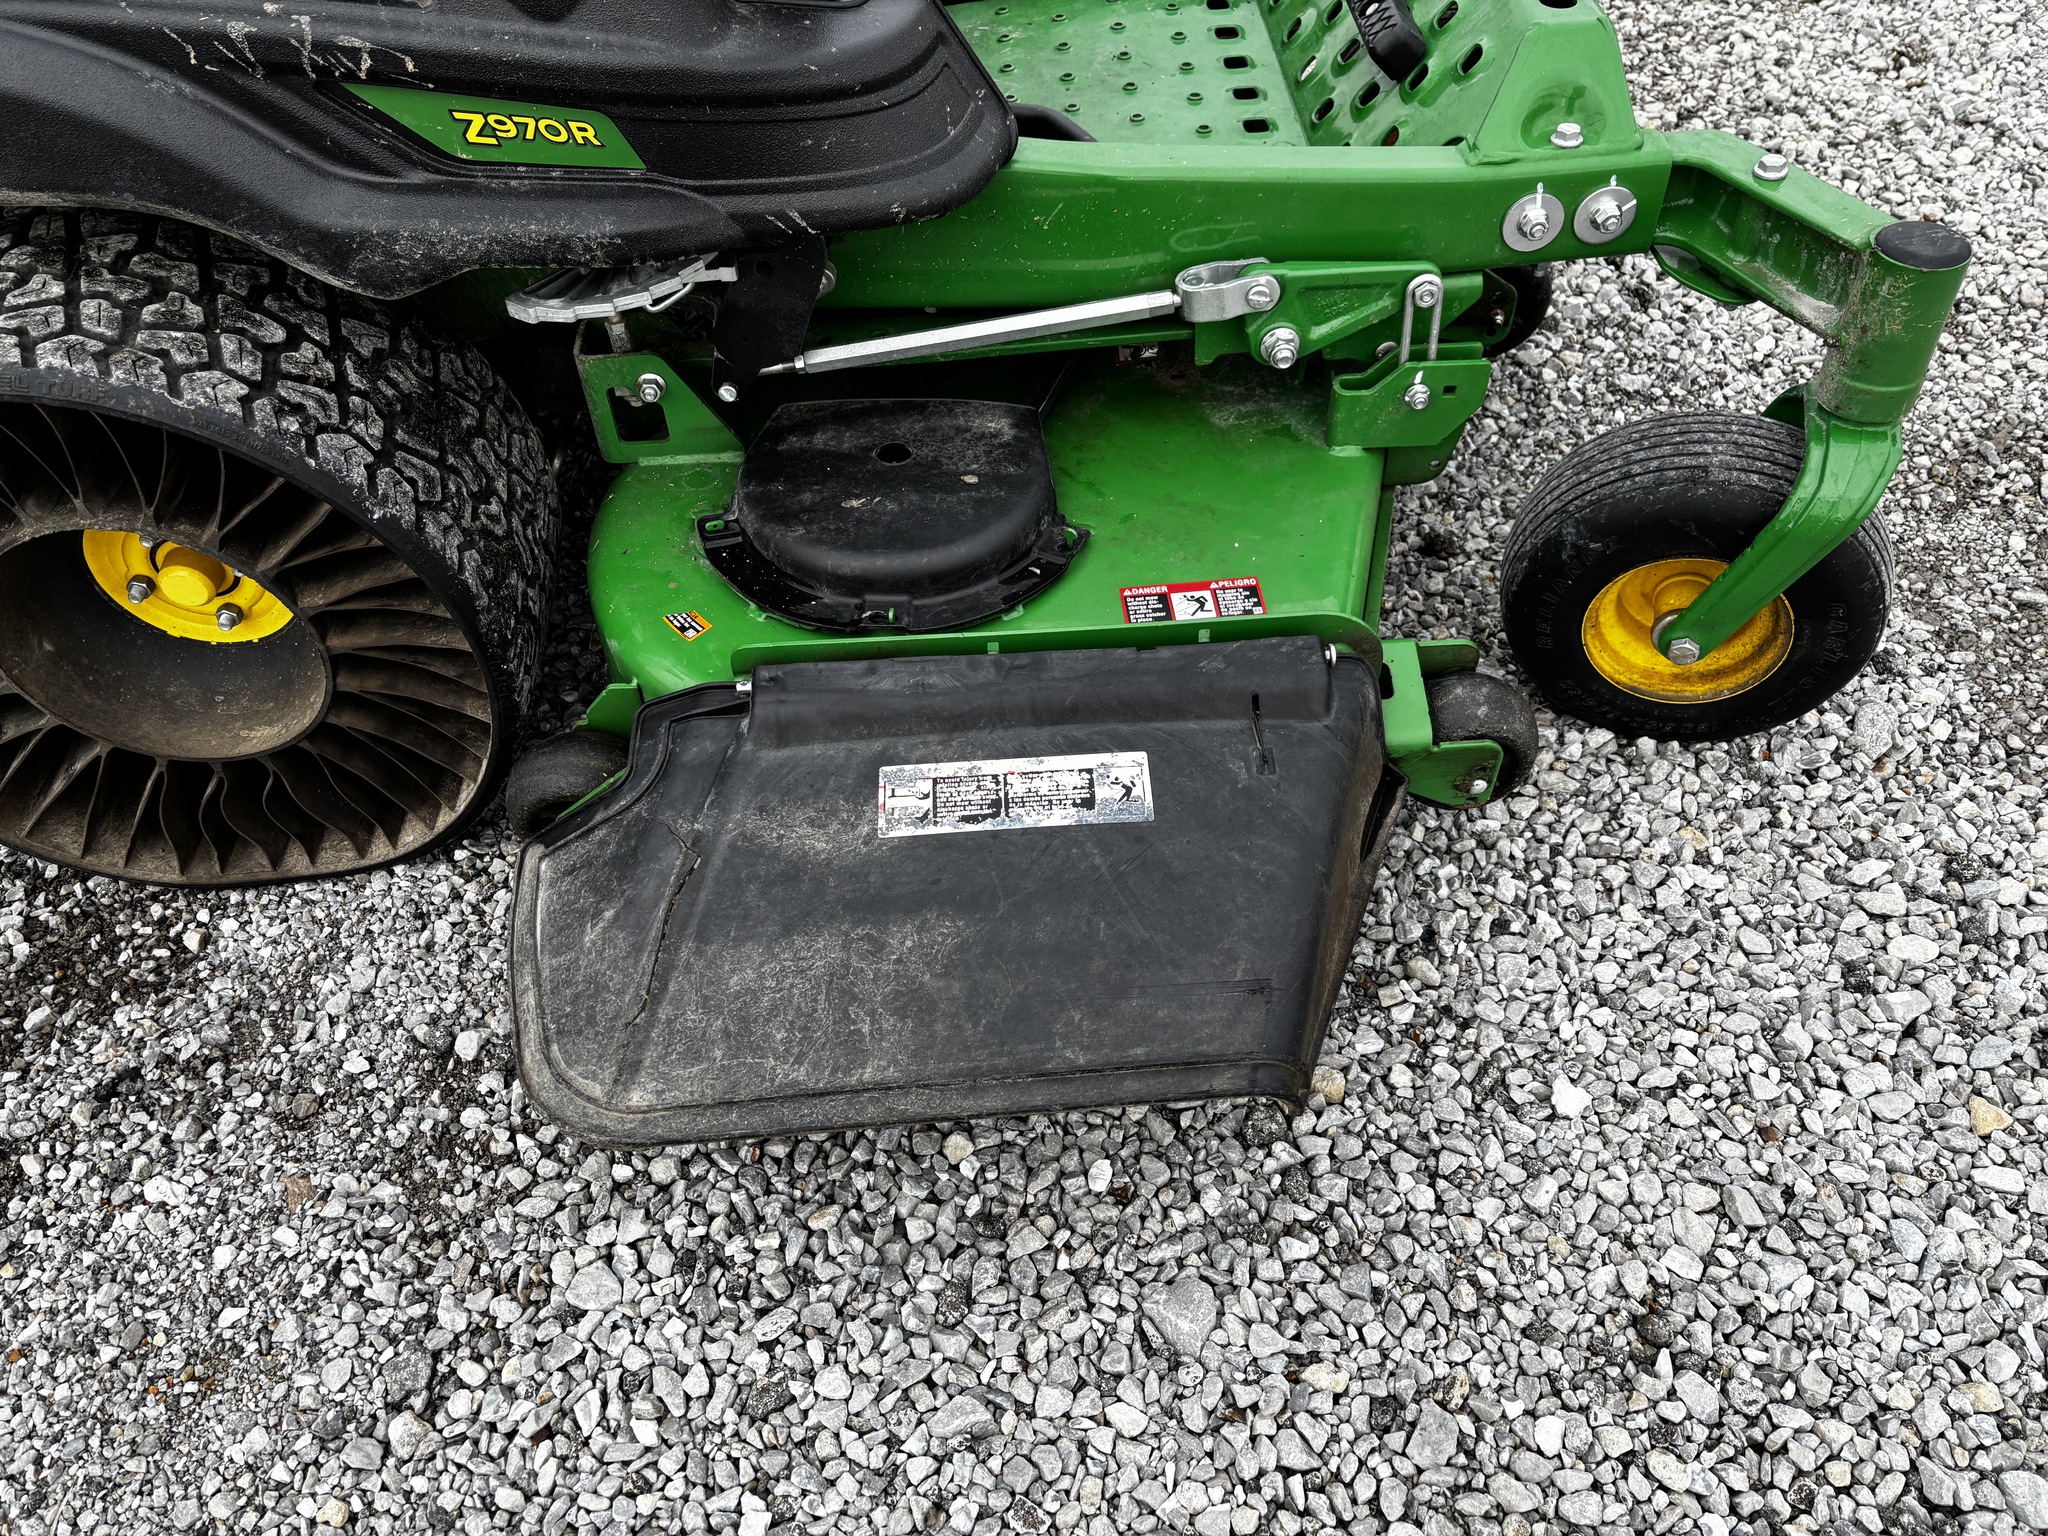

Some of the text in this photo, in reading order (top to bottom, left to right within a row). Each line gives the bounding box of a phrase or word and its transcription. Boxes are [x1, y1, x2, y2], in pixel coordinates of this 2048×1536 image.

[450, 110, 604, 147] Z970R
[1132, 586, 1168, 595] DANGER
[1218, 578, 1256, 588] PELIGRO
[1536, 536, 1620, 648] RELIANCE
